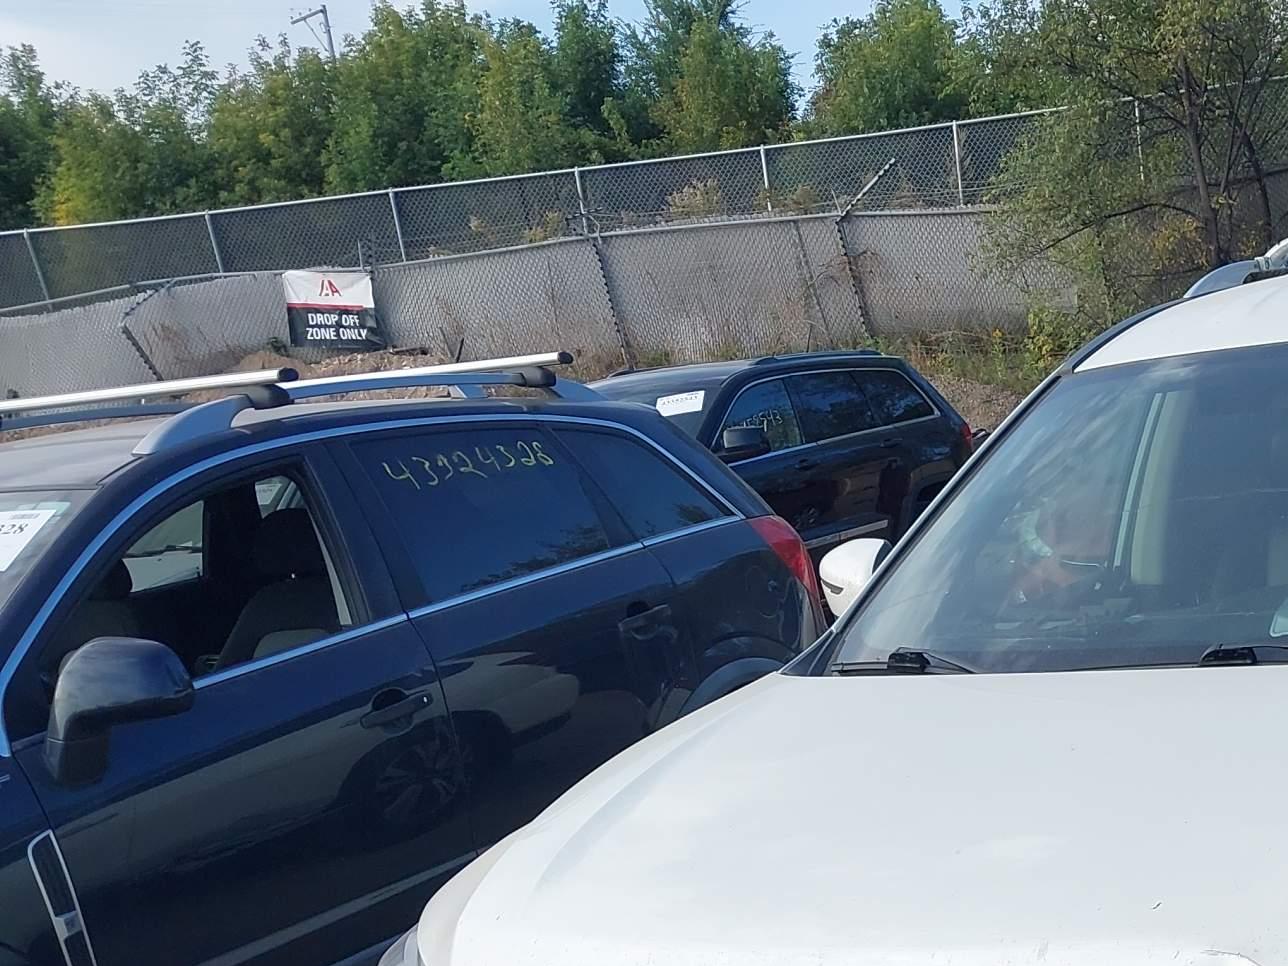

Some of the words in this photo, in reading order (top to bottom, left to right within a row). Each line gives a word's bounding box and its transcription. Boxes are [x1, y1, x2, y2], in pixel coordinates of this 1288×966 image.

[308, 313, 339, 326] DROP
[341, 314, 360, 327] OFF
[306, 327, 338, 340] ZONE
[340, 328, 368, 341] ONLY
